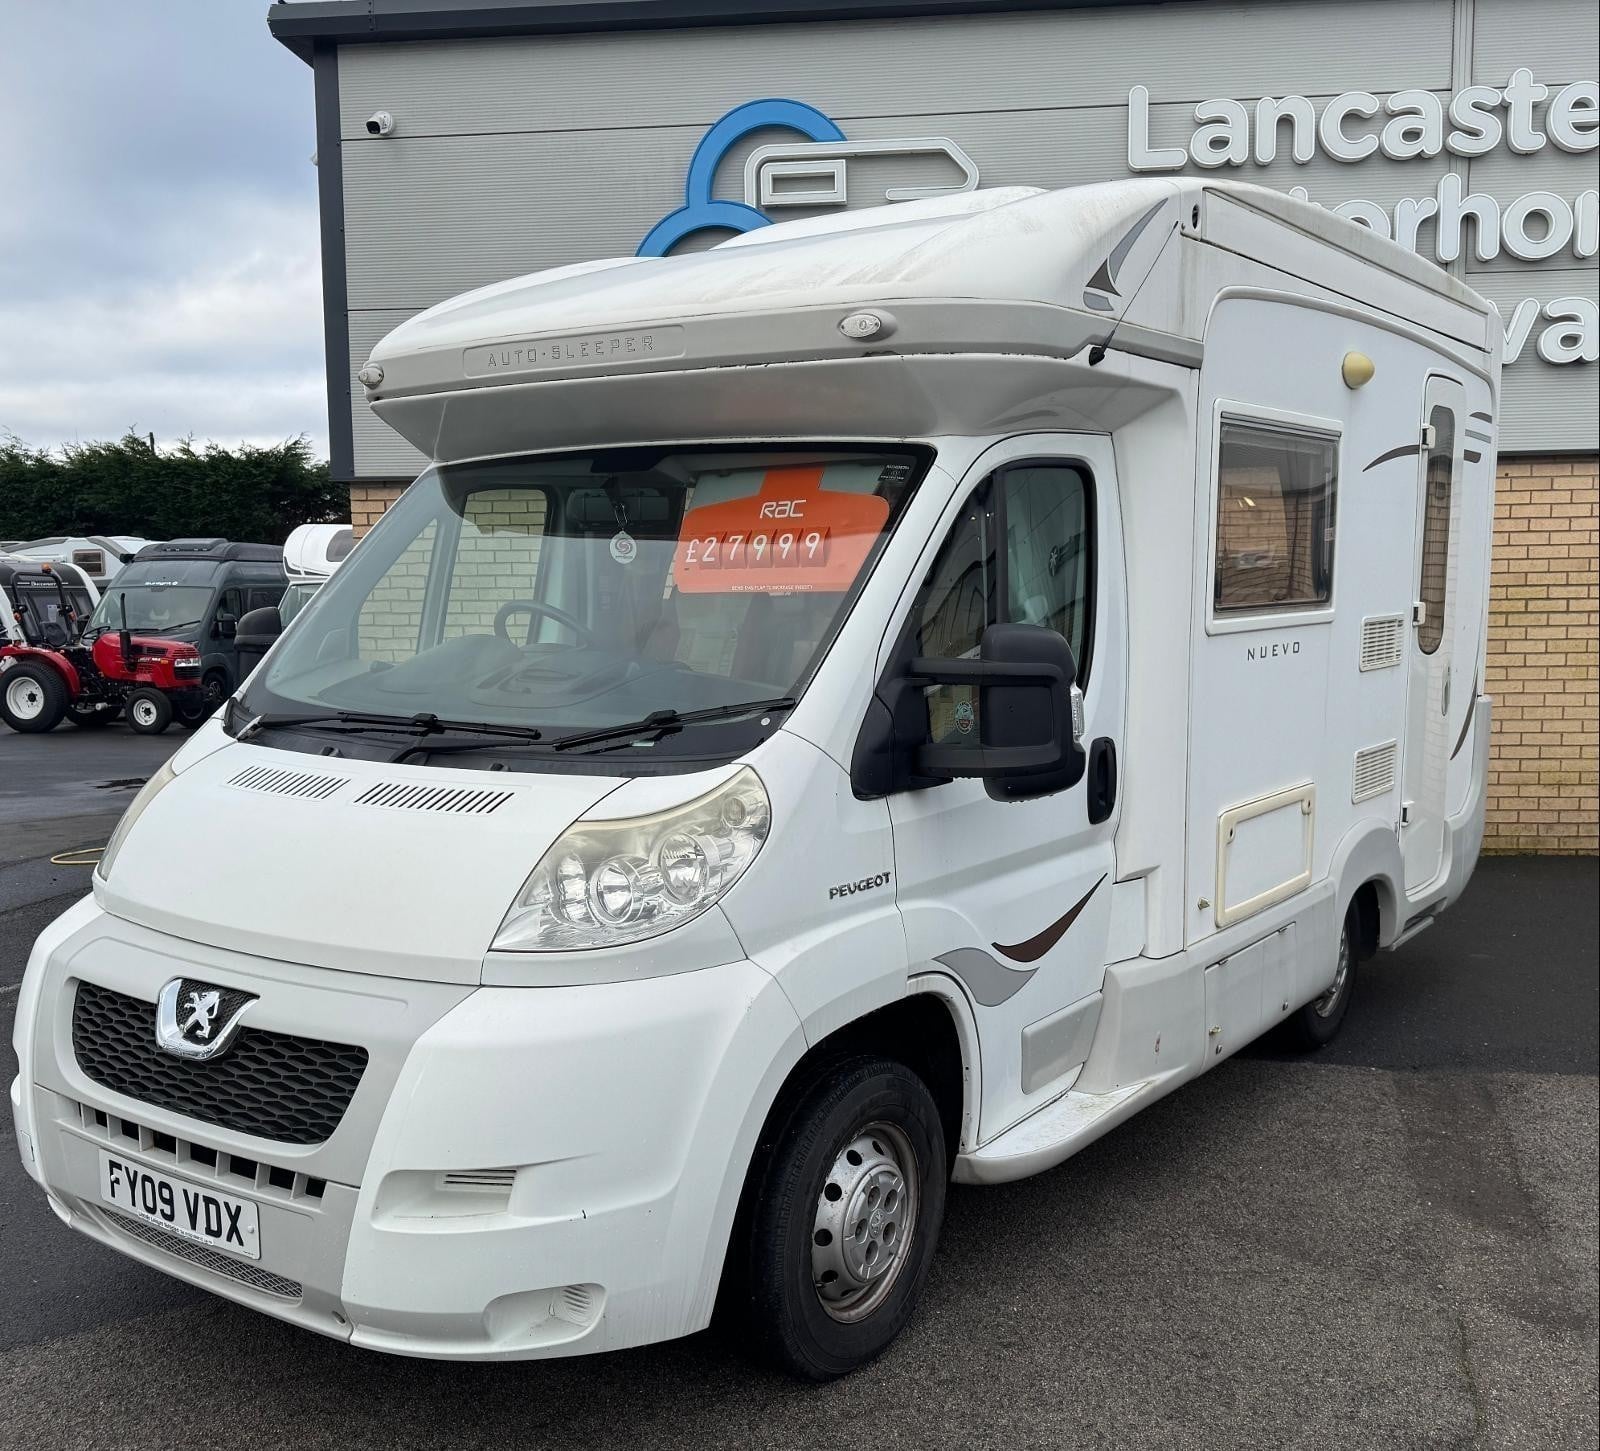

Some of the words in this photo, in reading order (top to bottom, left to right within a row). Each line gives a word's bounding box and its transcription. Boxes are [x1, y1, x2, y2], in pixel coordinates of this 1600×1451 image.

[685, 532, 821, 563] £27999
[1247, 641, 1300, 661] NUEVO
[828, 871, 891, 900] PEUGEOT
[108, 1159, 176, 1222] FY09
[182, 1188, 245, 1247] VDX
